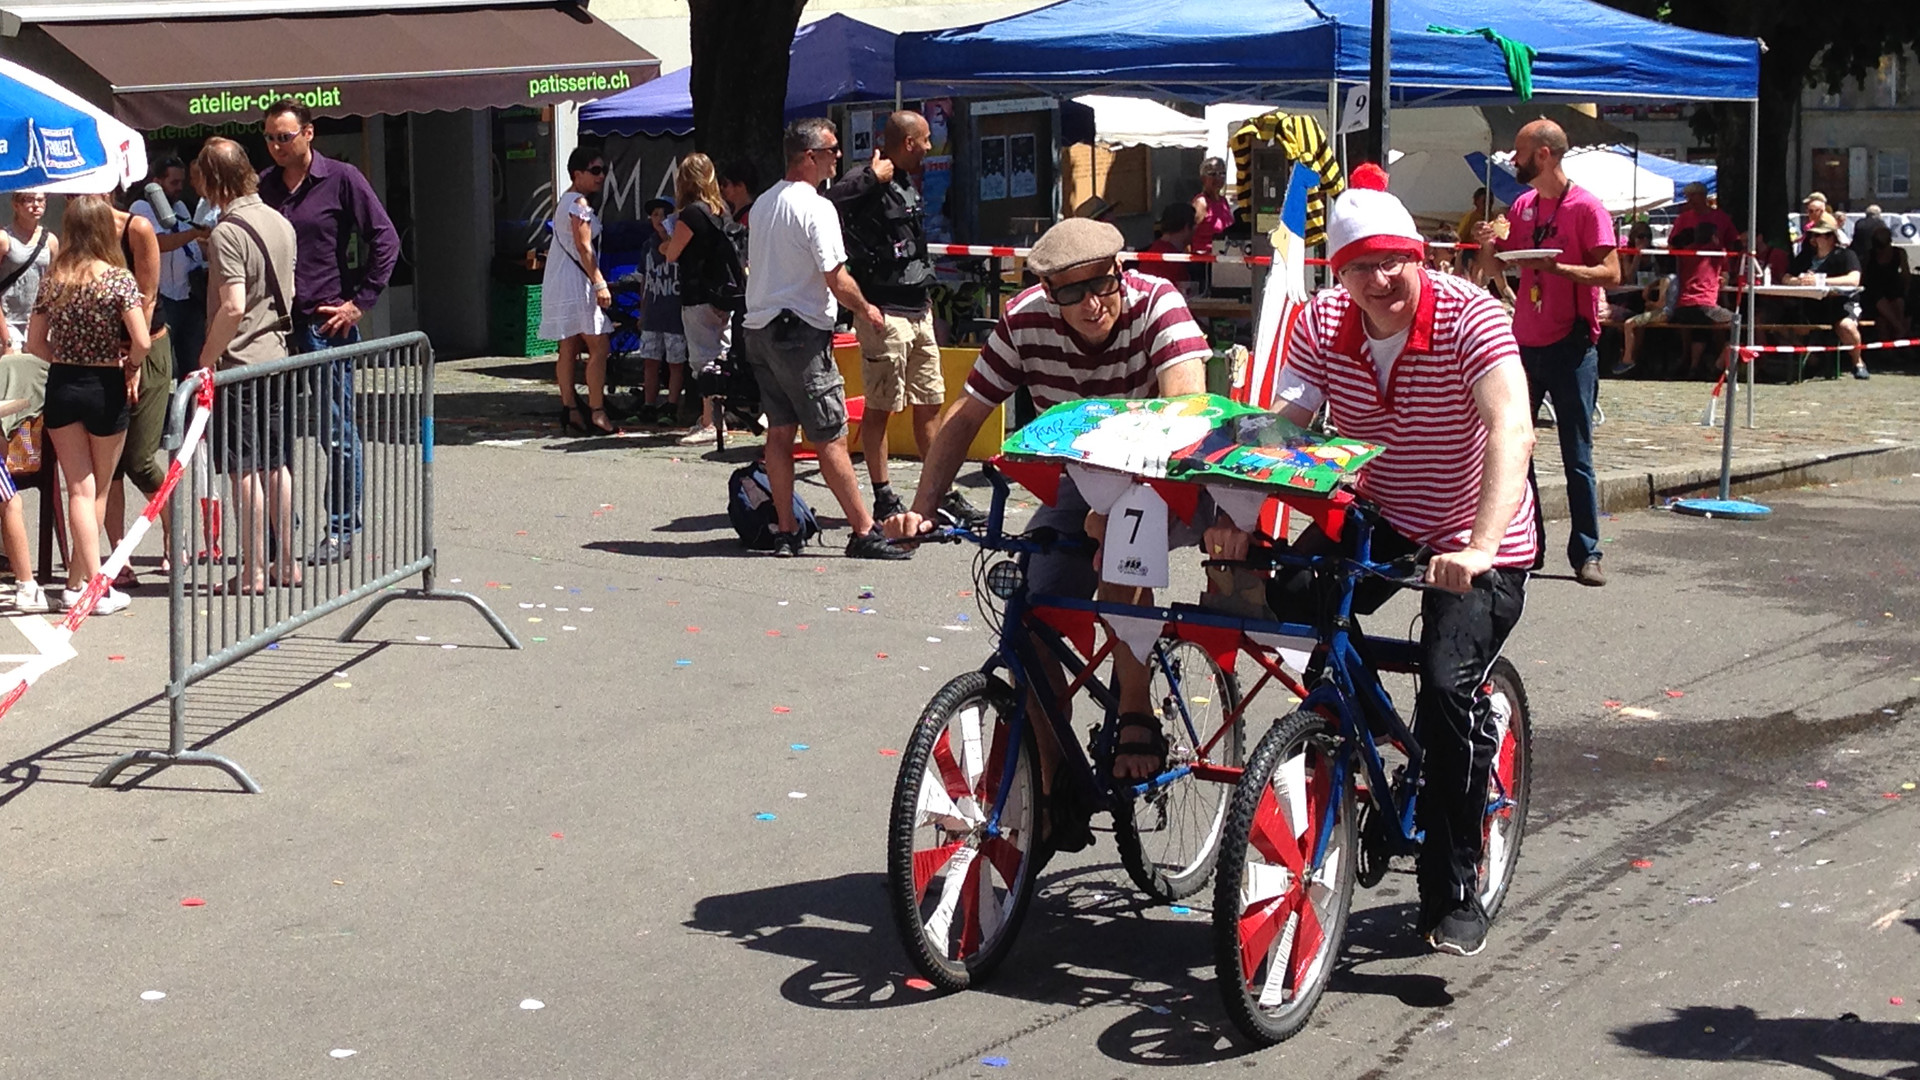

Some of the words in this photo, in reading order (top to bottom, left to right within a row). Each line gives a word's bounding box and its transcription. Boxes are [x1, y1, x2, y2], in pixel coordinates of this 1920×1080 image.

[529, 70, 630, 98] patisserie.ch
[1355, 94, 1367, 114] 9
[1123, 507, 1145, 545] 7
